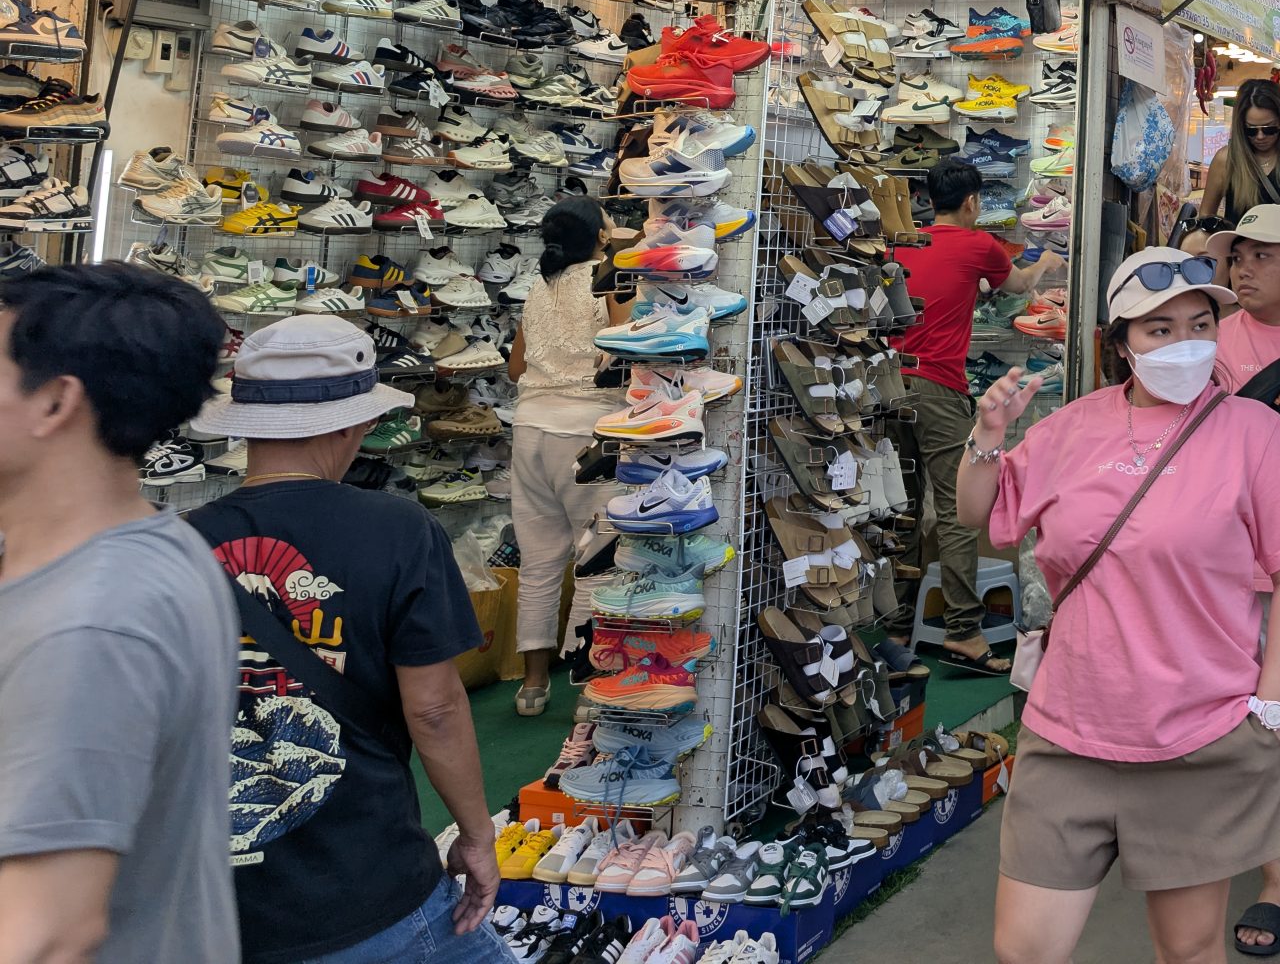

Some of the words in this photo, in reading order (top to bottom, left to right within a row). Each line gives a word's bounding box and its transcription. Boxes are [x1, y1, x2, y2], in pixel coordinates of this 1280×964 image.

[1115, 462, 1149, 475] GOOD
[643, 537, 675, 558] HOKA
[624, 580, 657, 596] HOKA
[622, 725, 653, 742] HOKA
[598, 769, 633, 783] HOKA
